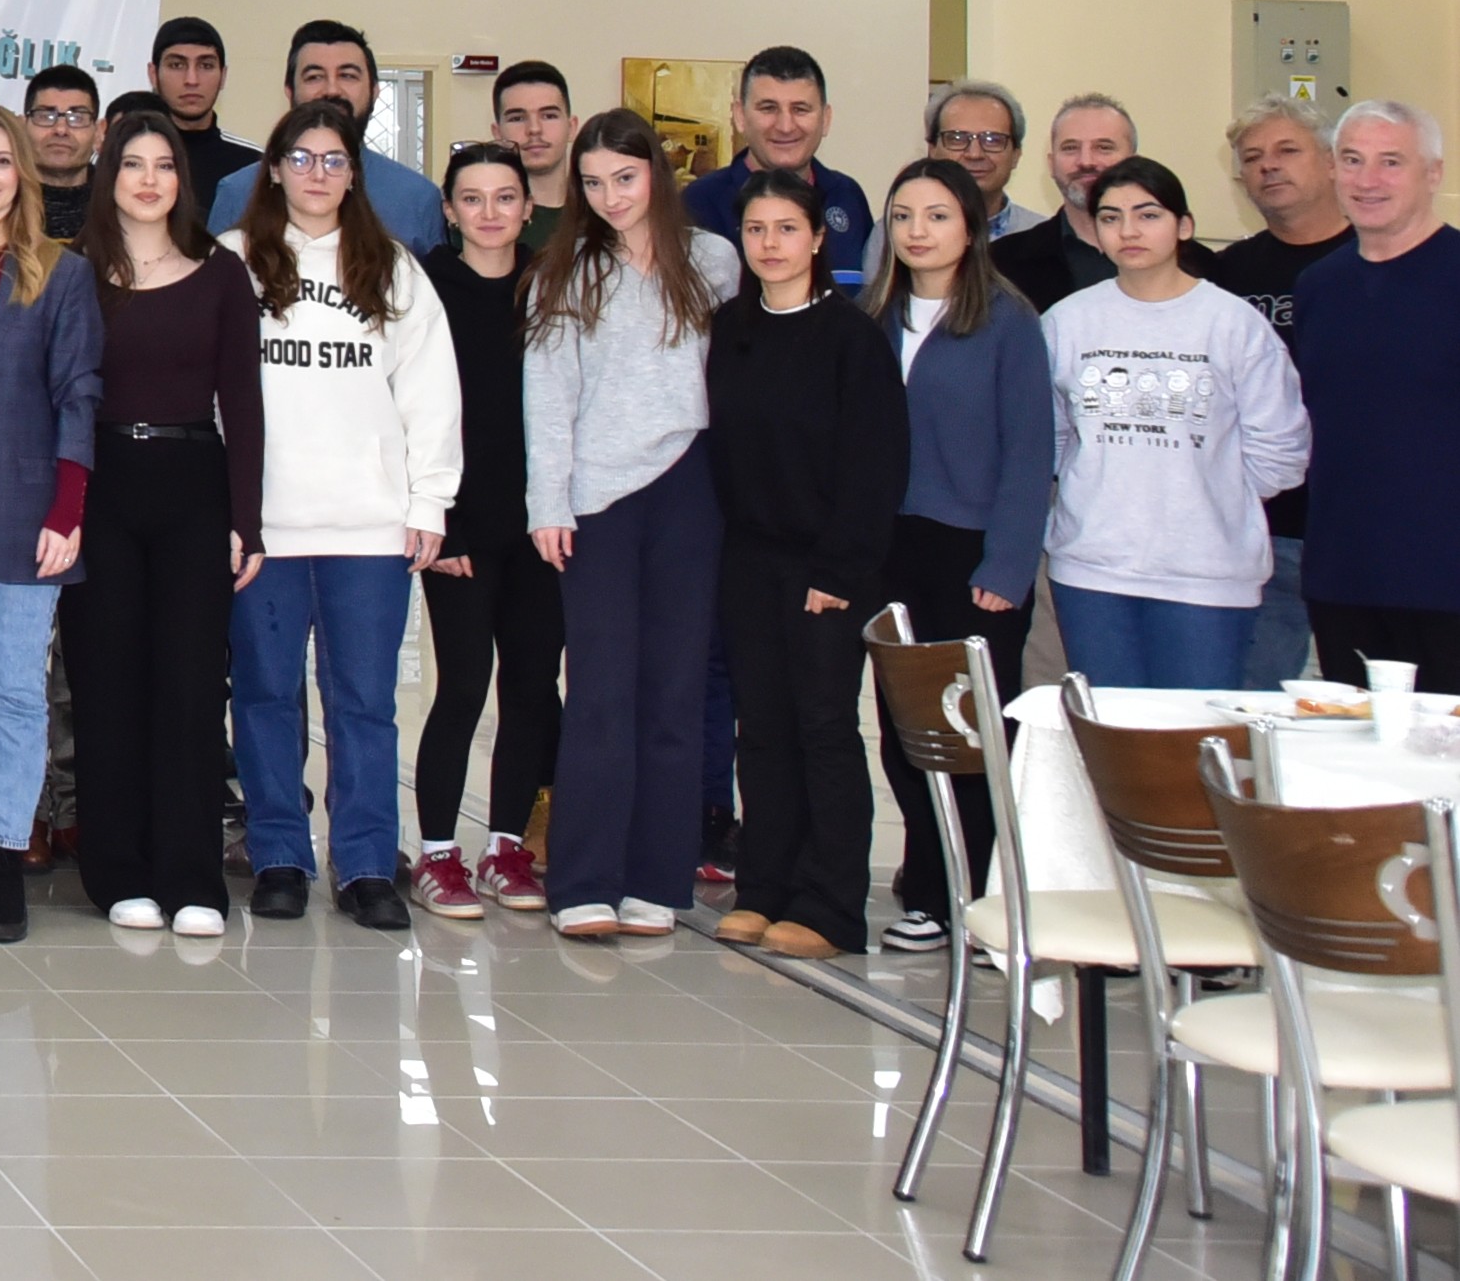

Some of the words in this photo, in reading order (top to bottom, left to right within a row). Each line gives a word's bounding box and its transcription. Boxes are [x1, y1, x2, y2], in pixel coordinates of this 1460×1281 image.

[318, 341, 373, 369] STAR
[1131, 349, 1177, 360] SOCIAL
[1103, 422, 1132, 432] NEW
[1134, 424, 1168, 435] YORK
